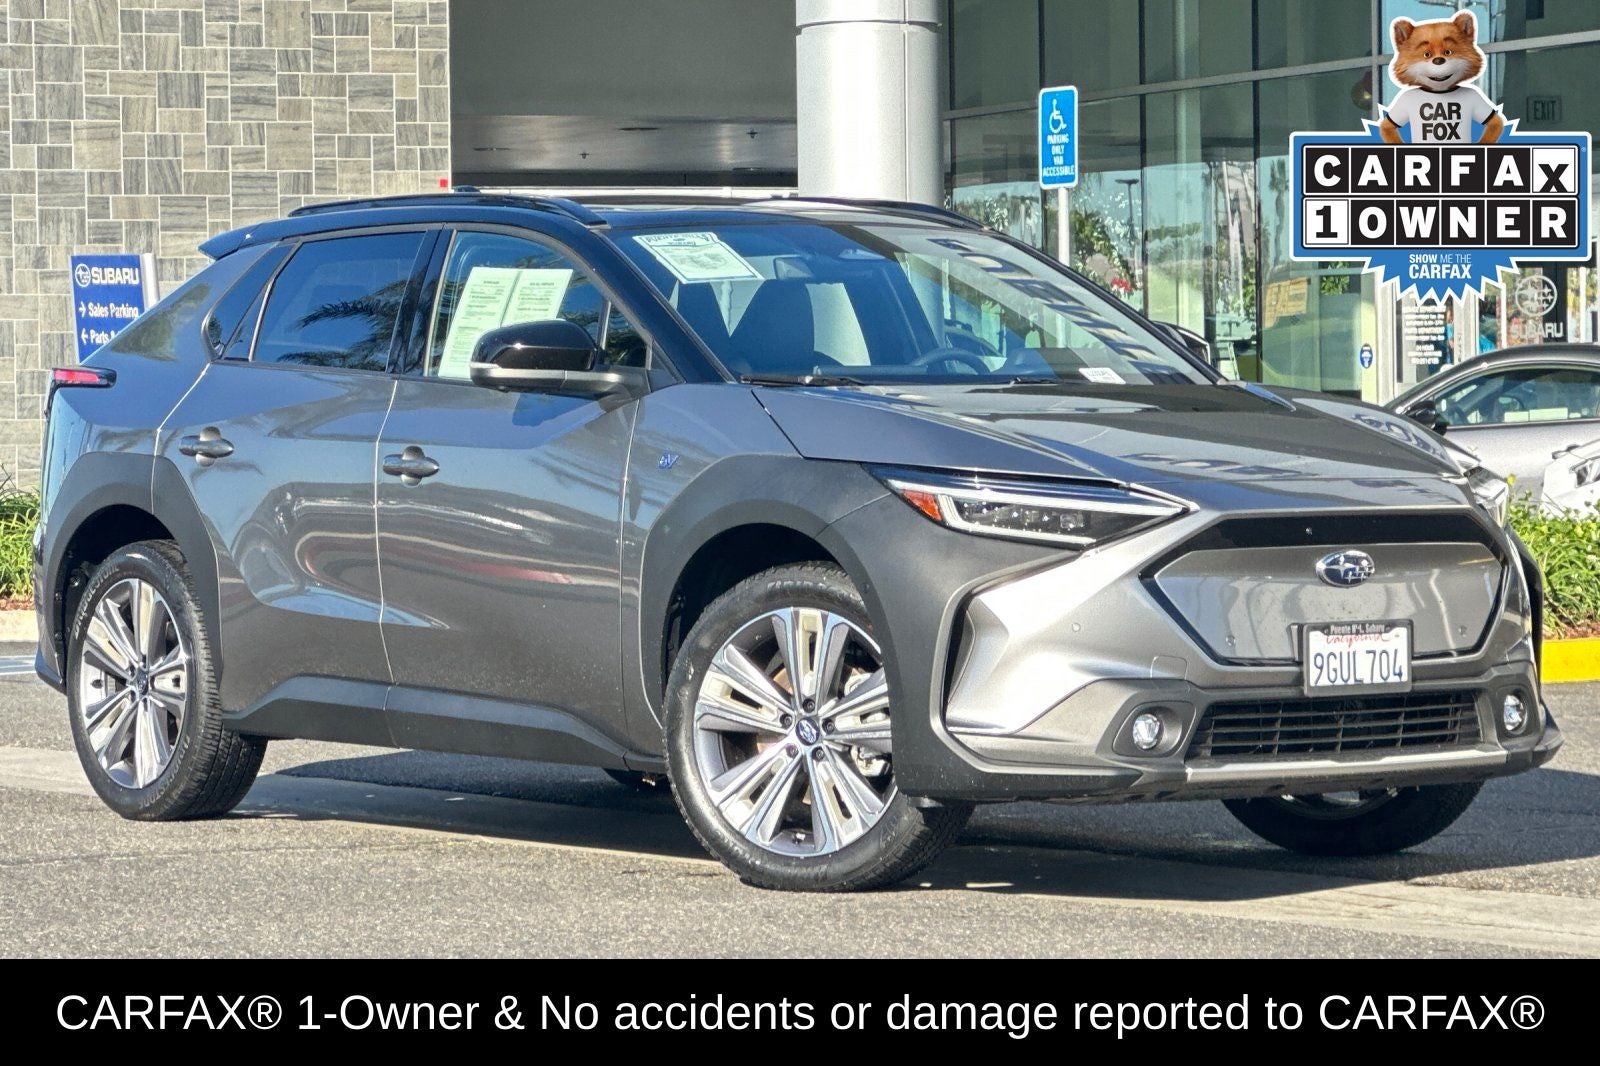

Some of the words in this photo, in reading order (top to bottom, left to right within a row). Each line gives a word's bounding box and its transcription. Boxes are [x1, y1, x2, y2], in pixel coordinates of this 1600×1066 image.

[1533, 100, 1557, 121] EXIT
[1047, 133, 1070, 145] PARKING
[1051, 145, 1065, 156] ONLY
[1053, 155, 1064, 166] VAN
[1042, 164, 1075, 178] ACCESSIBLE
[91, 267, 140, 285] SUBARU
[88, 302, 109, 318] Sales
[109, 302, 139, 320] Parking
[90, 329, 109, 345] Parts
[1510, 319, 1564, 339] SUBARU
